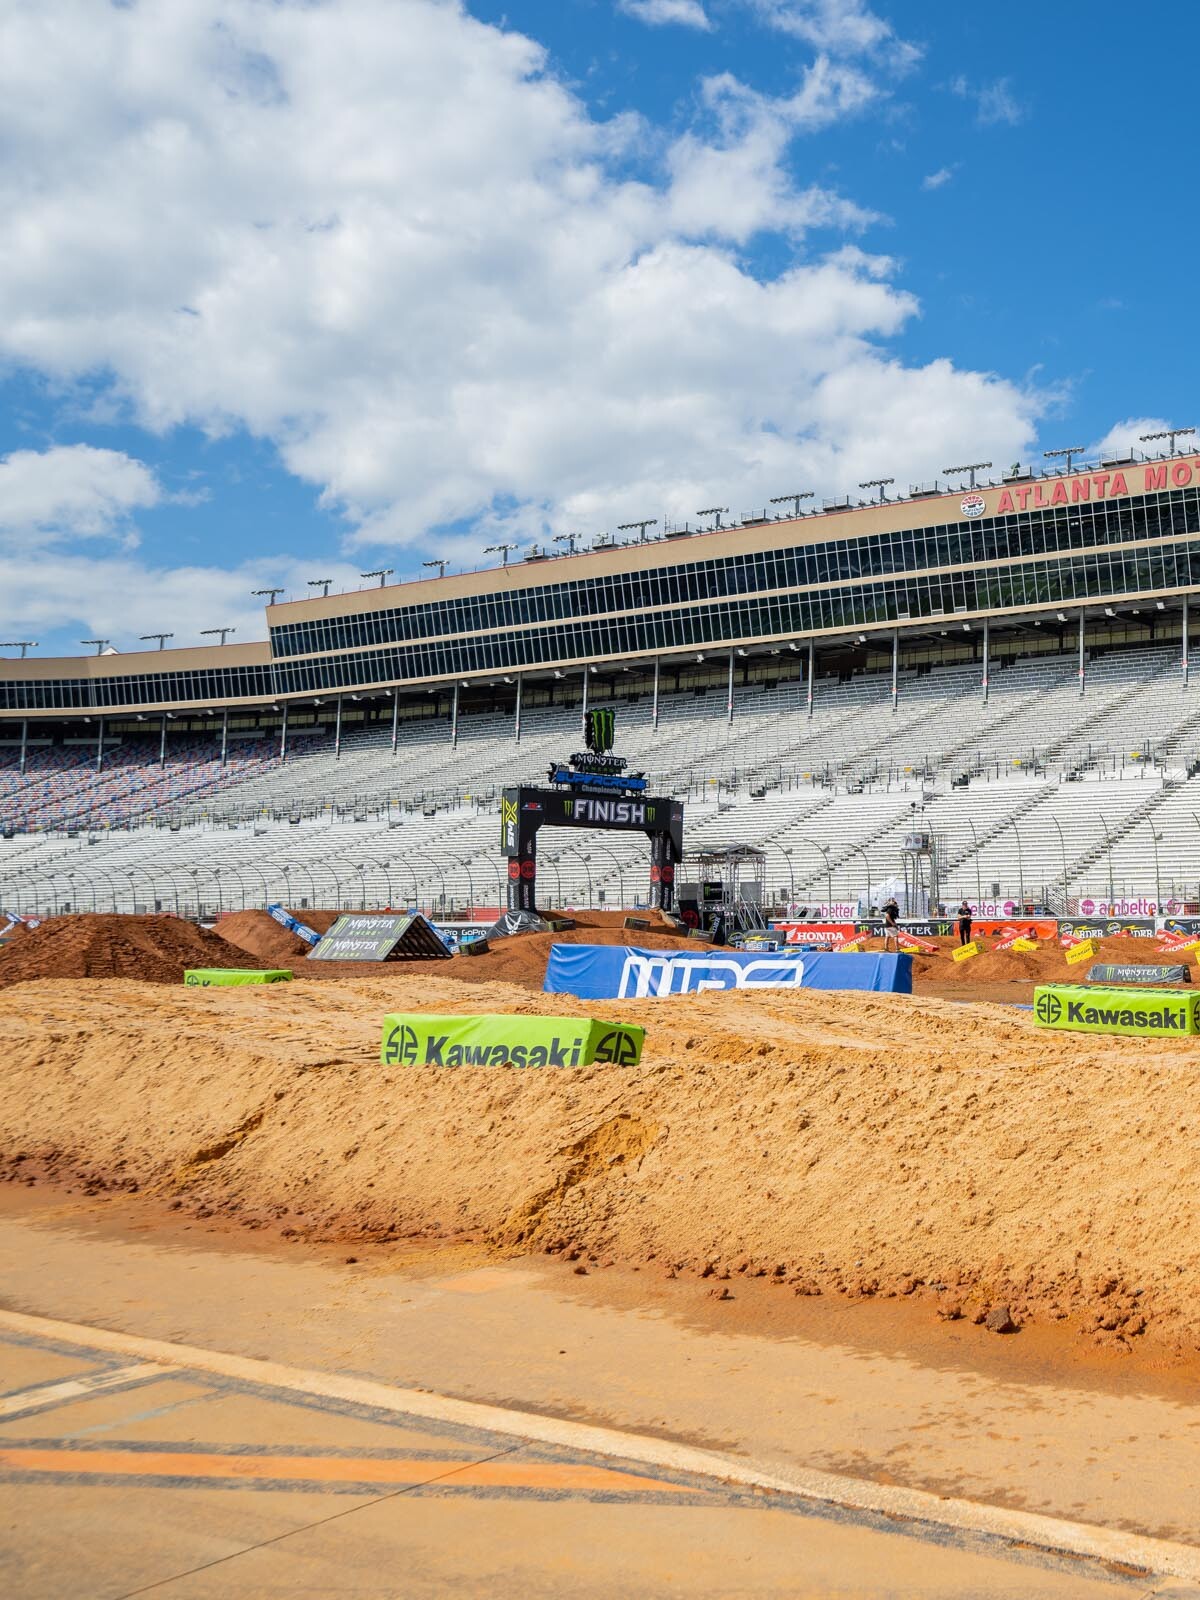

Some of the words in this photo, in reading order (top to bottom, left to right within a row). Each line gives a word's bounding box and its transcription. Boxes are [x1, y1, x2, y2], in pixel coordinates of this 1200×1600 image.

[997, 472, 1129, 514] ATLANTA
[577, 754, 627, 768] MONSTER
[574, 799, 645, 824] FINISH
[820, 903, 856, 918] better
[1099, 898, 1157, 915] ambette
[348, 917, 396, 929] MONSTER
[873, 924, 933, 936] MSTER
[796, 931, 846, 941] HONDA
[332, 940, 379, 951] MONSTER
[1117, 967, 1158, 977] MONSTER
[1067, 1001, 1186, 1030] Kawasaki
[425, 1036, 584, 1068] Kawasaki
